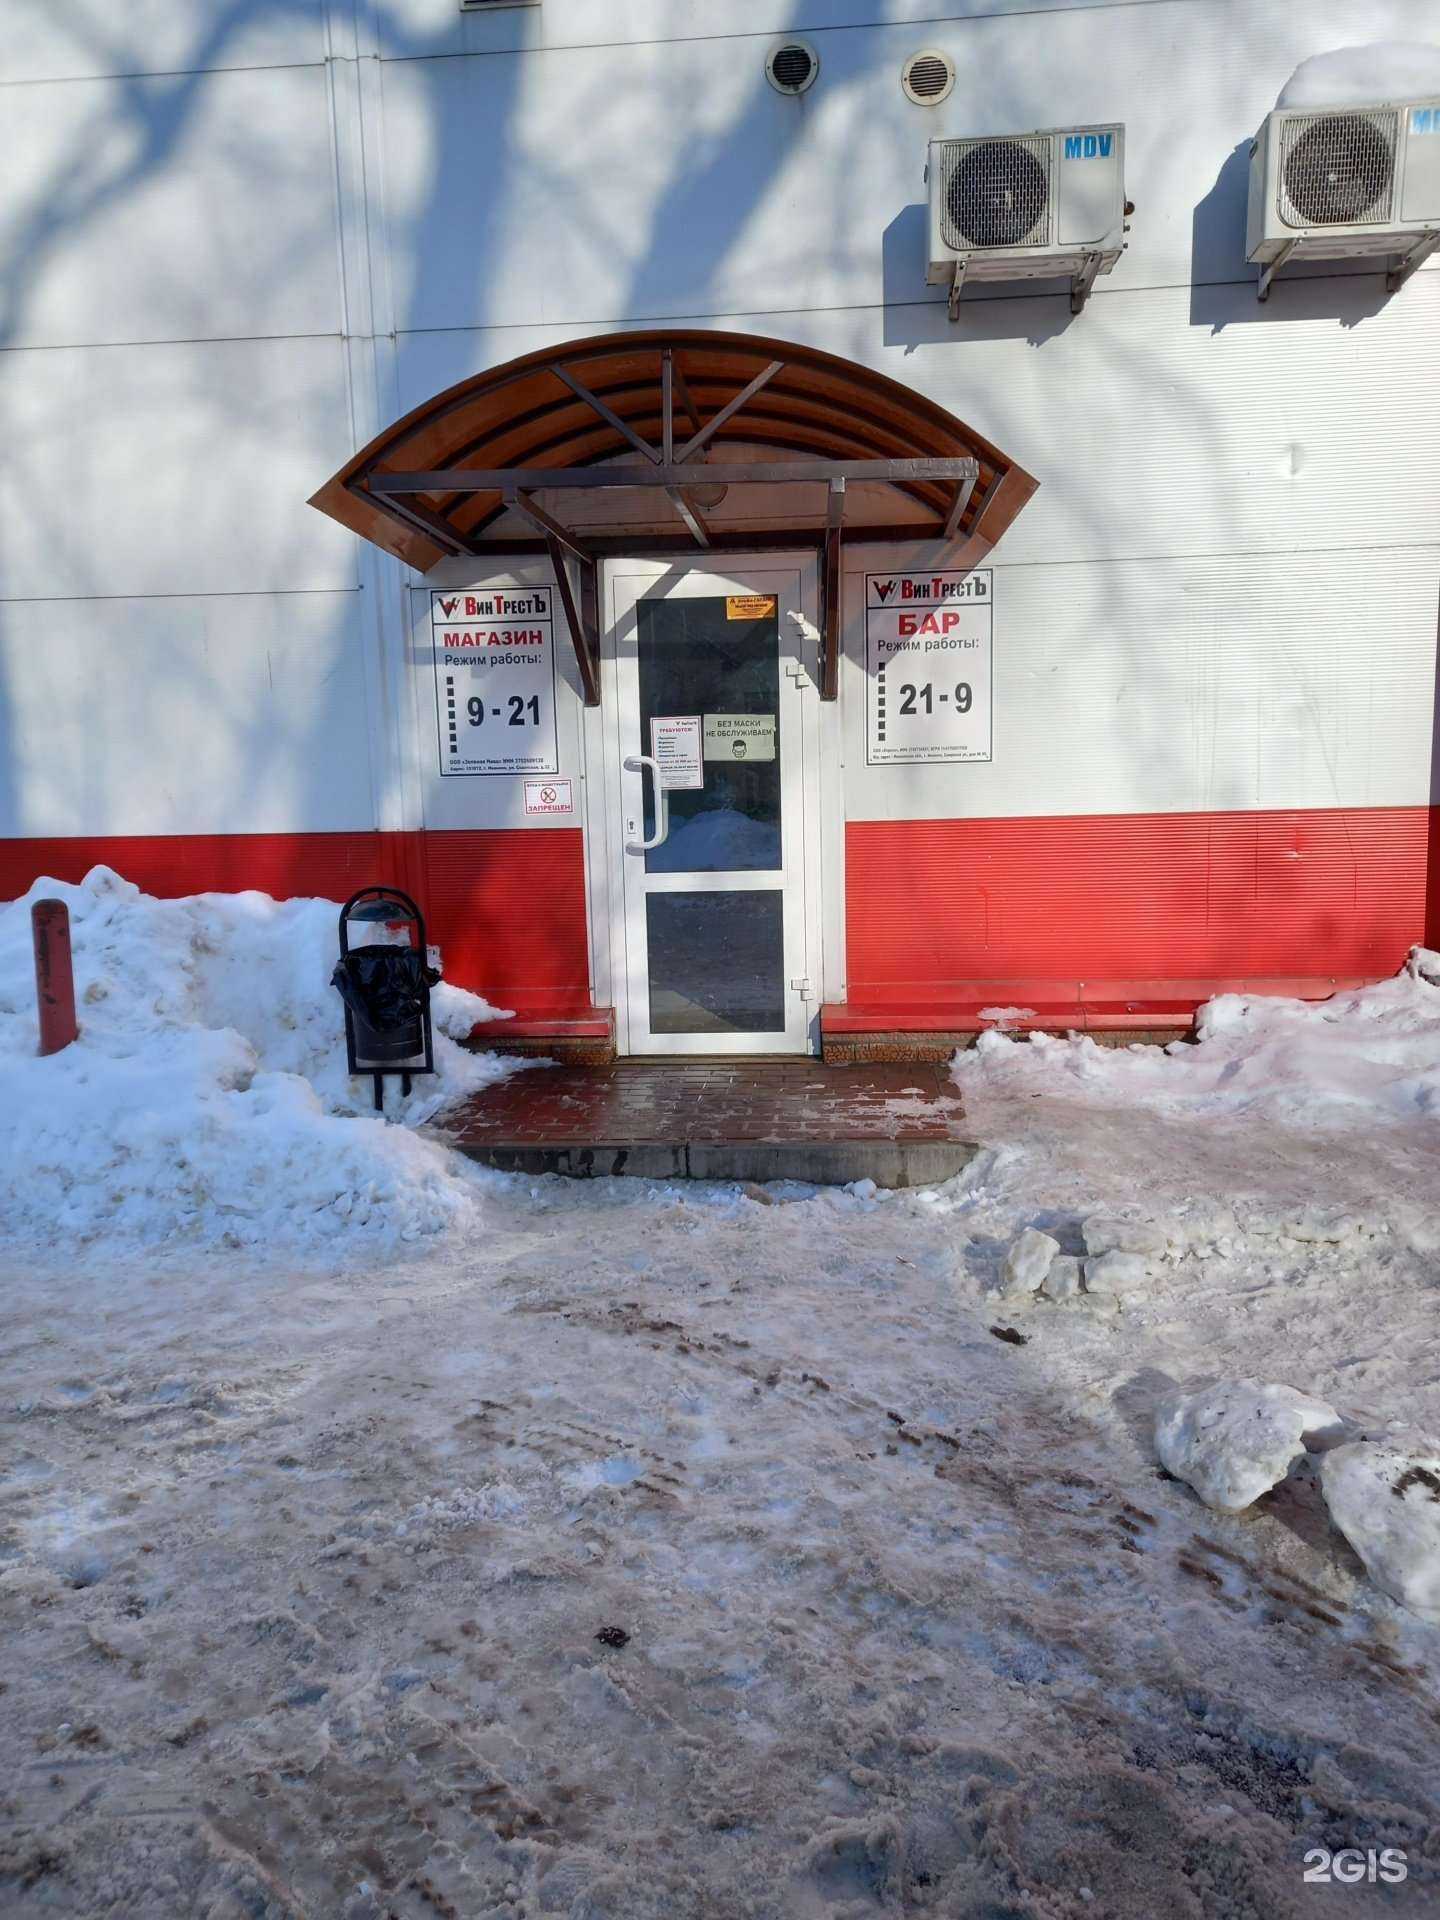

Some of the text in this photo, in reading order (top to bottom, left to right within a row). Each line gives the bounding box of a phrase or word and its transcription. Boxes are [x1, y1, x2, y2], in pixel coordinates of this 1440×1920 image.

[1065, 134, 1112, 160] MDV
[899, 612, 960, 635] БАР
[443, 630, 543, 647] МАГАЗИН
[878, 637, 979, 652] Режим работы:
[445, 652, 542, 668] Режим работы:
[717, 719, 761, 728] БЕЗ МАСКИ
[717, 729, 772, 737] ОБСЛУЖИВАЕМ
